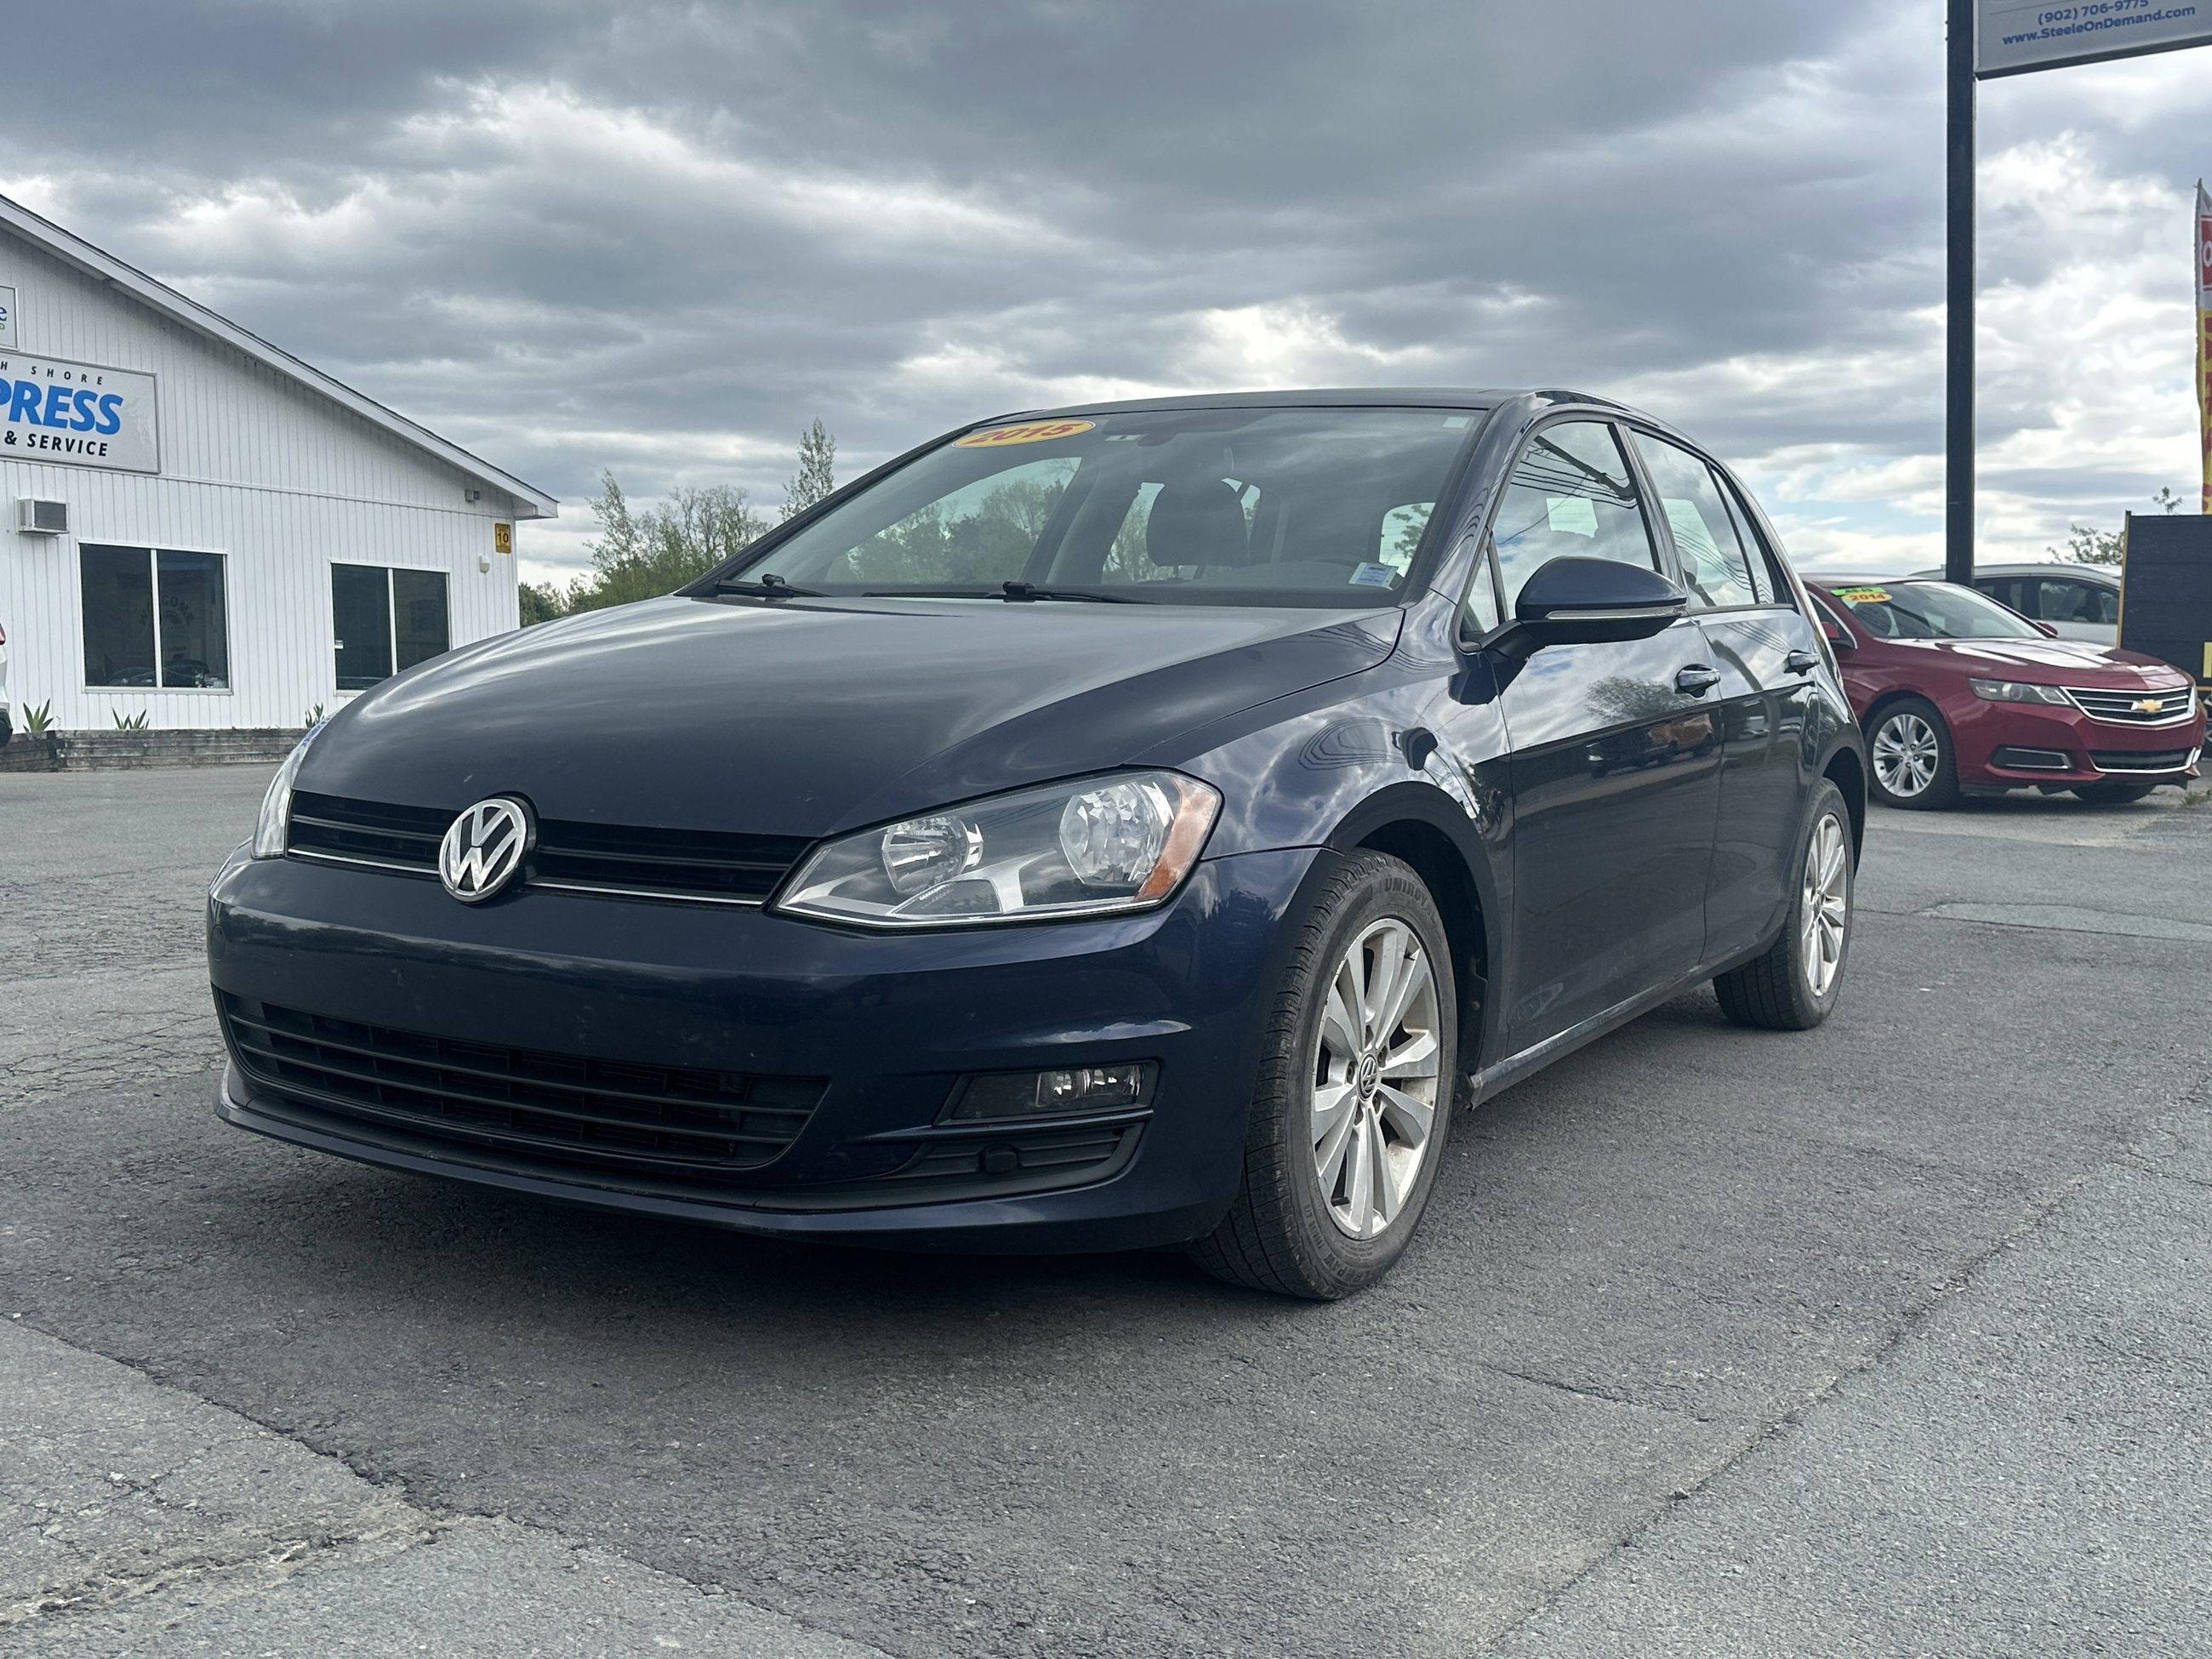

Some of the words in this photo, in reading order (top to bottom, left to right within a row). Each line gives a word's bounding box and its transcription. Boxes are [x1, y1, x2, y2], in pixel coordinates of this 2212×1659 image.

[2003, 6, 2196, 44] www.SteeleOnDemand.com
[2038, 8, 2078, 26] (902)
[2081, 0, 2149, 18] 706-9775
[31, 366, 103, 385] SHORE
[4, 430, 17, 446] &
[27, 433, 108, 457] SERVICE
[963, 423, 1085, 445] 2015
[1849, 593, 1886, 601] 2014
